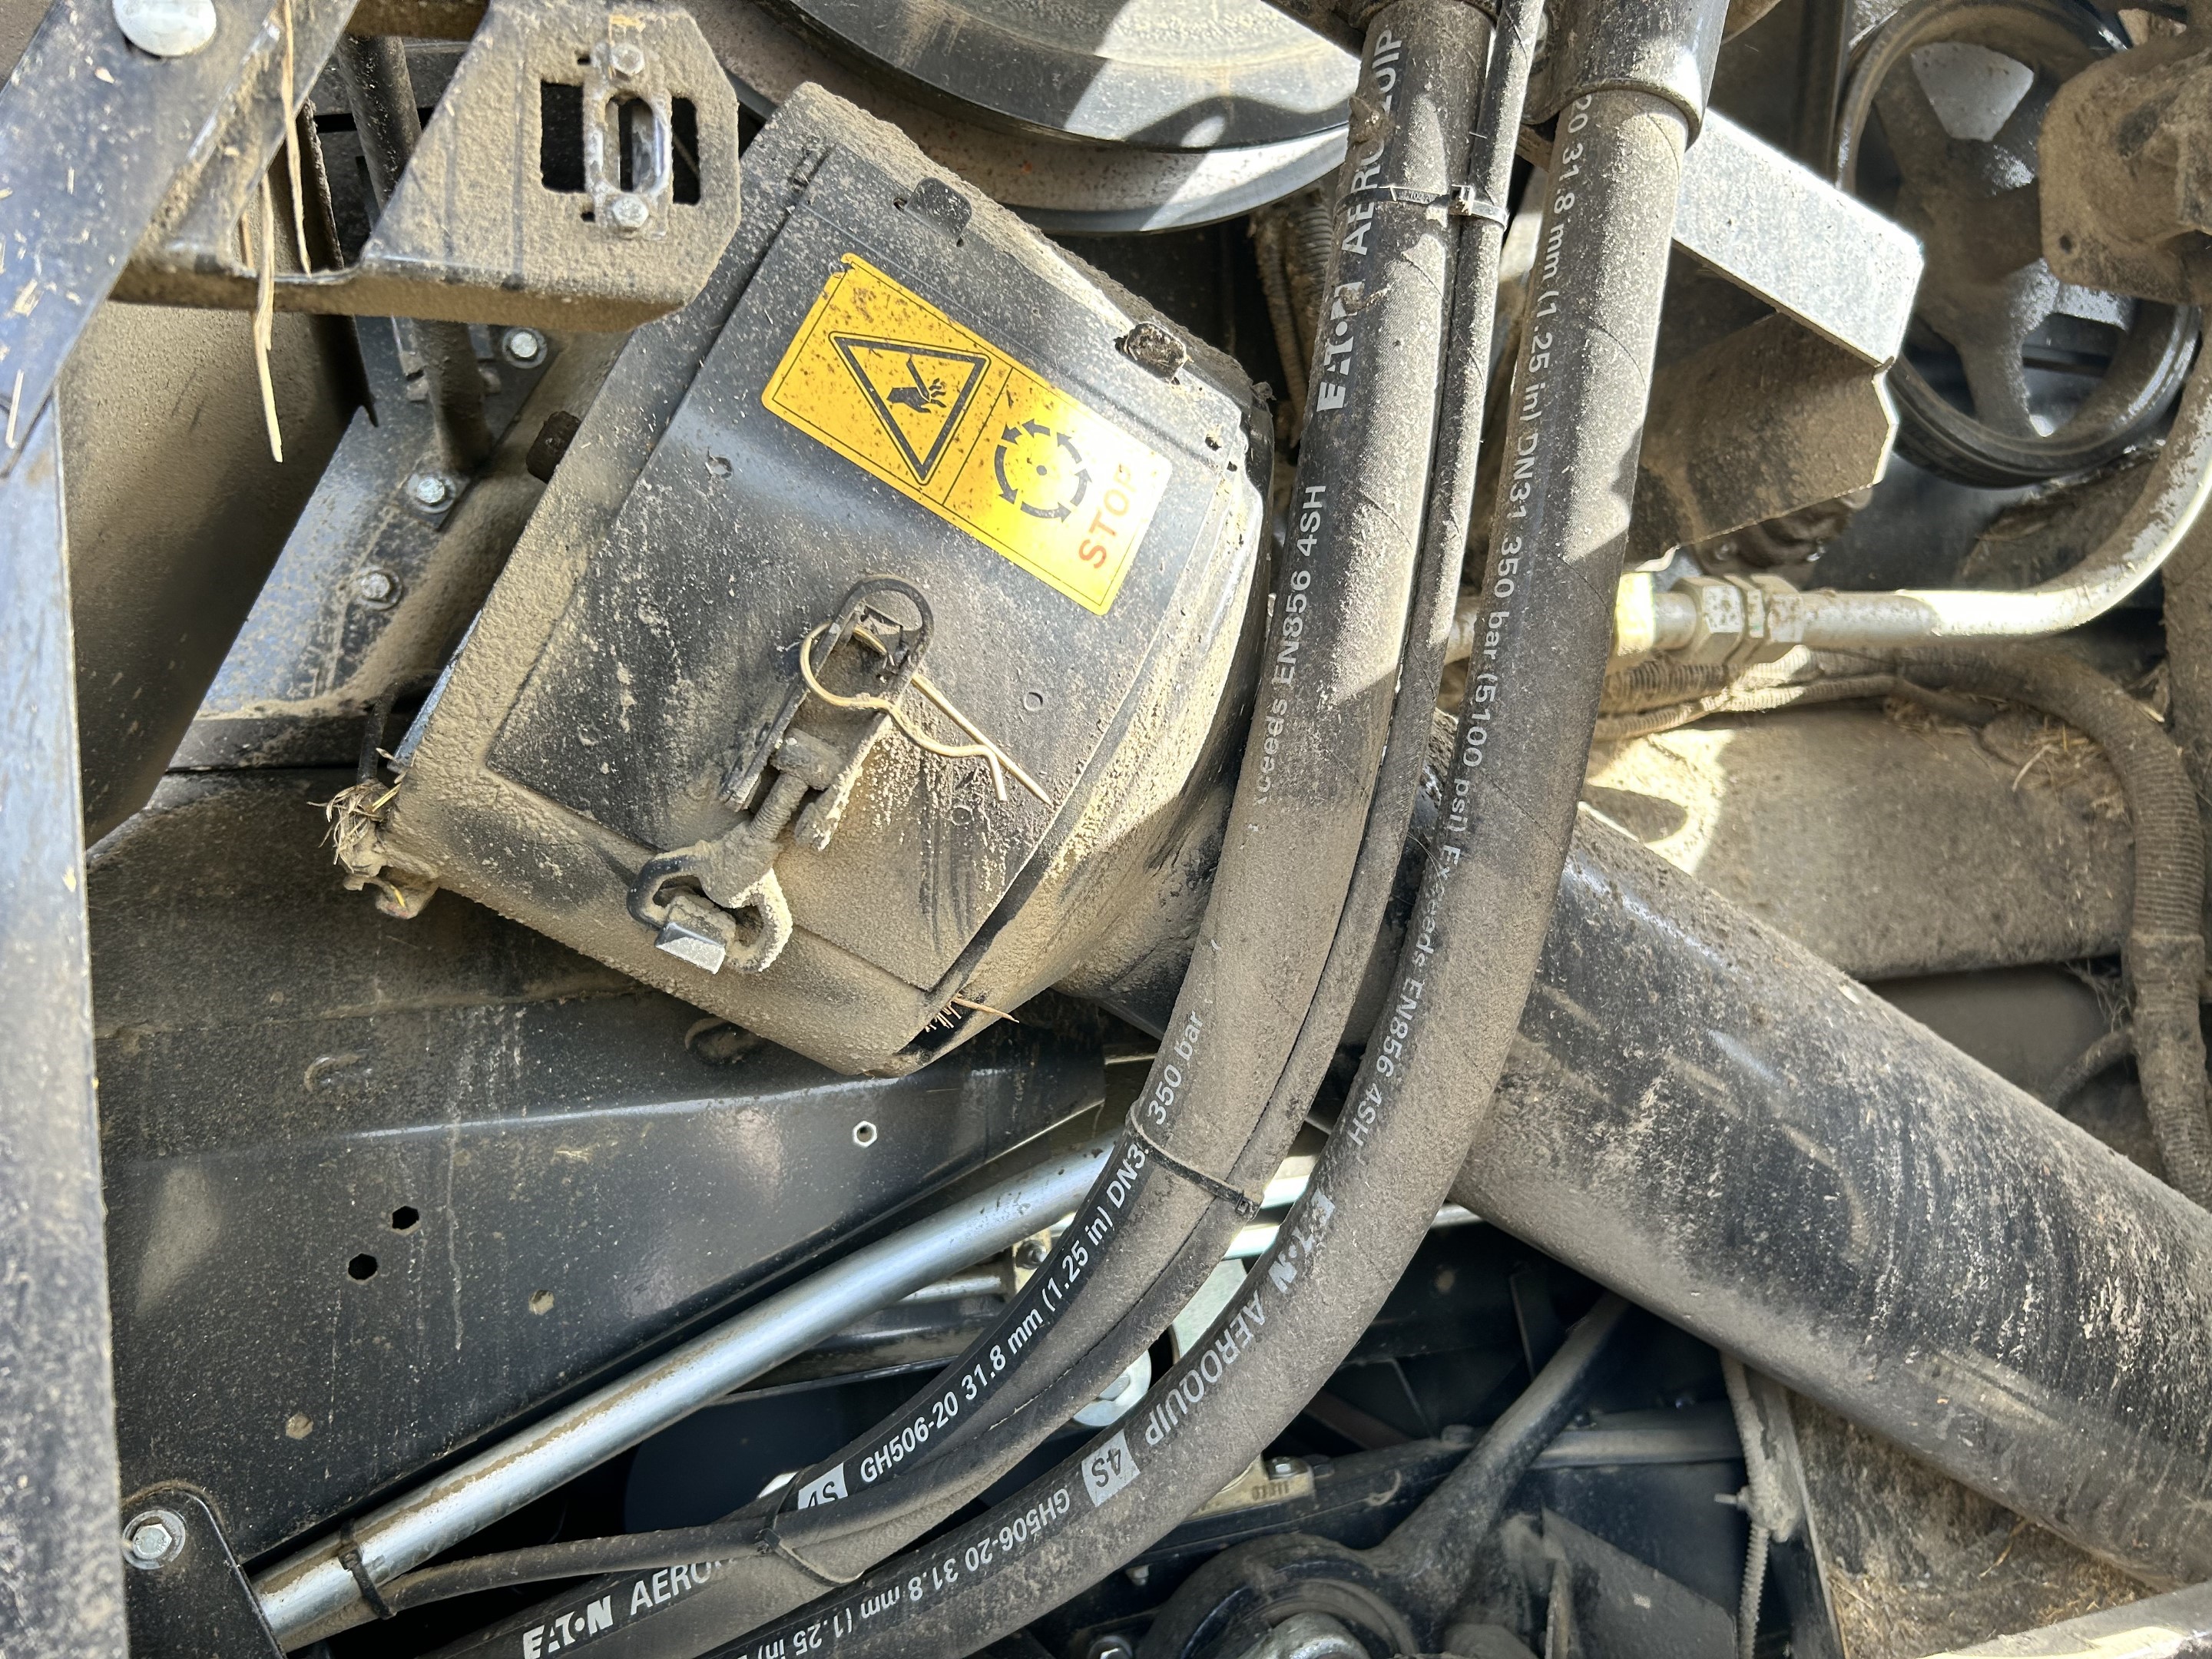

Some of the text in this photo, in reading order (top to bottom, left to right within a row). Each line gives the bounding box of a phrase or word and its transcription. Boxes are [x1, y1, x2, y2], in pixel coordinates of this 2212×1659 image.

[1554, 143, 1583, 214] 31.8
[1542, 223, 1565, 280] mm
[1528, 290, 1559, 373] (1.25
[1519, 382, 1546, 421] in)
[1507, 432, 1538, 518] DN31
[1078, 463, 1137, 569] STOP
[1271, 570, 1311, 685] EN856
[1296, 485, 1326, 557] 4SH
[1494, 536, 1522, 598] 350
[1483, 611, 1509, 660] bar
[1463, 673, 1498, 767] (5100
[1447, 778, 1470, 833] psi)
[1376, 977, 1424, 1078] EN856
[1347, 1082, 1382, 1147] 4SH
[860, 1391, 959, 1482] GH506-20
[961, 1345, 1006, 1400] 31.8
[1007, 1308, 1044, 1355] mm
[1041, 1240, 1088, 1312] (1.25
[1084, 1206, 1113, 1246] in)
[1106, 1143, 1149, 1209] DN3
[1147, 1064, 1182, 1124] 350
[1174, 1010, 1204, 1061] bar
[1144, 1290, 1266, 1445] AEROQUIP
[965, 1488, 1070, 1571] GH506-20
[860, 1585, 900, 1618] mm
[908, 1558, 959, 1601] 31.8
[793, 1608, 853, 1656] (1.25
